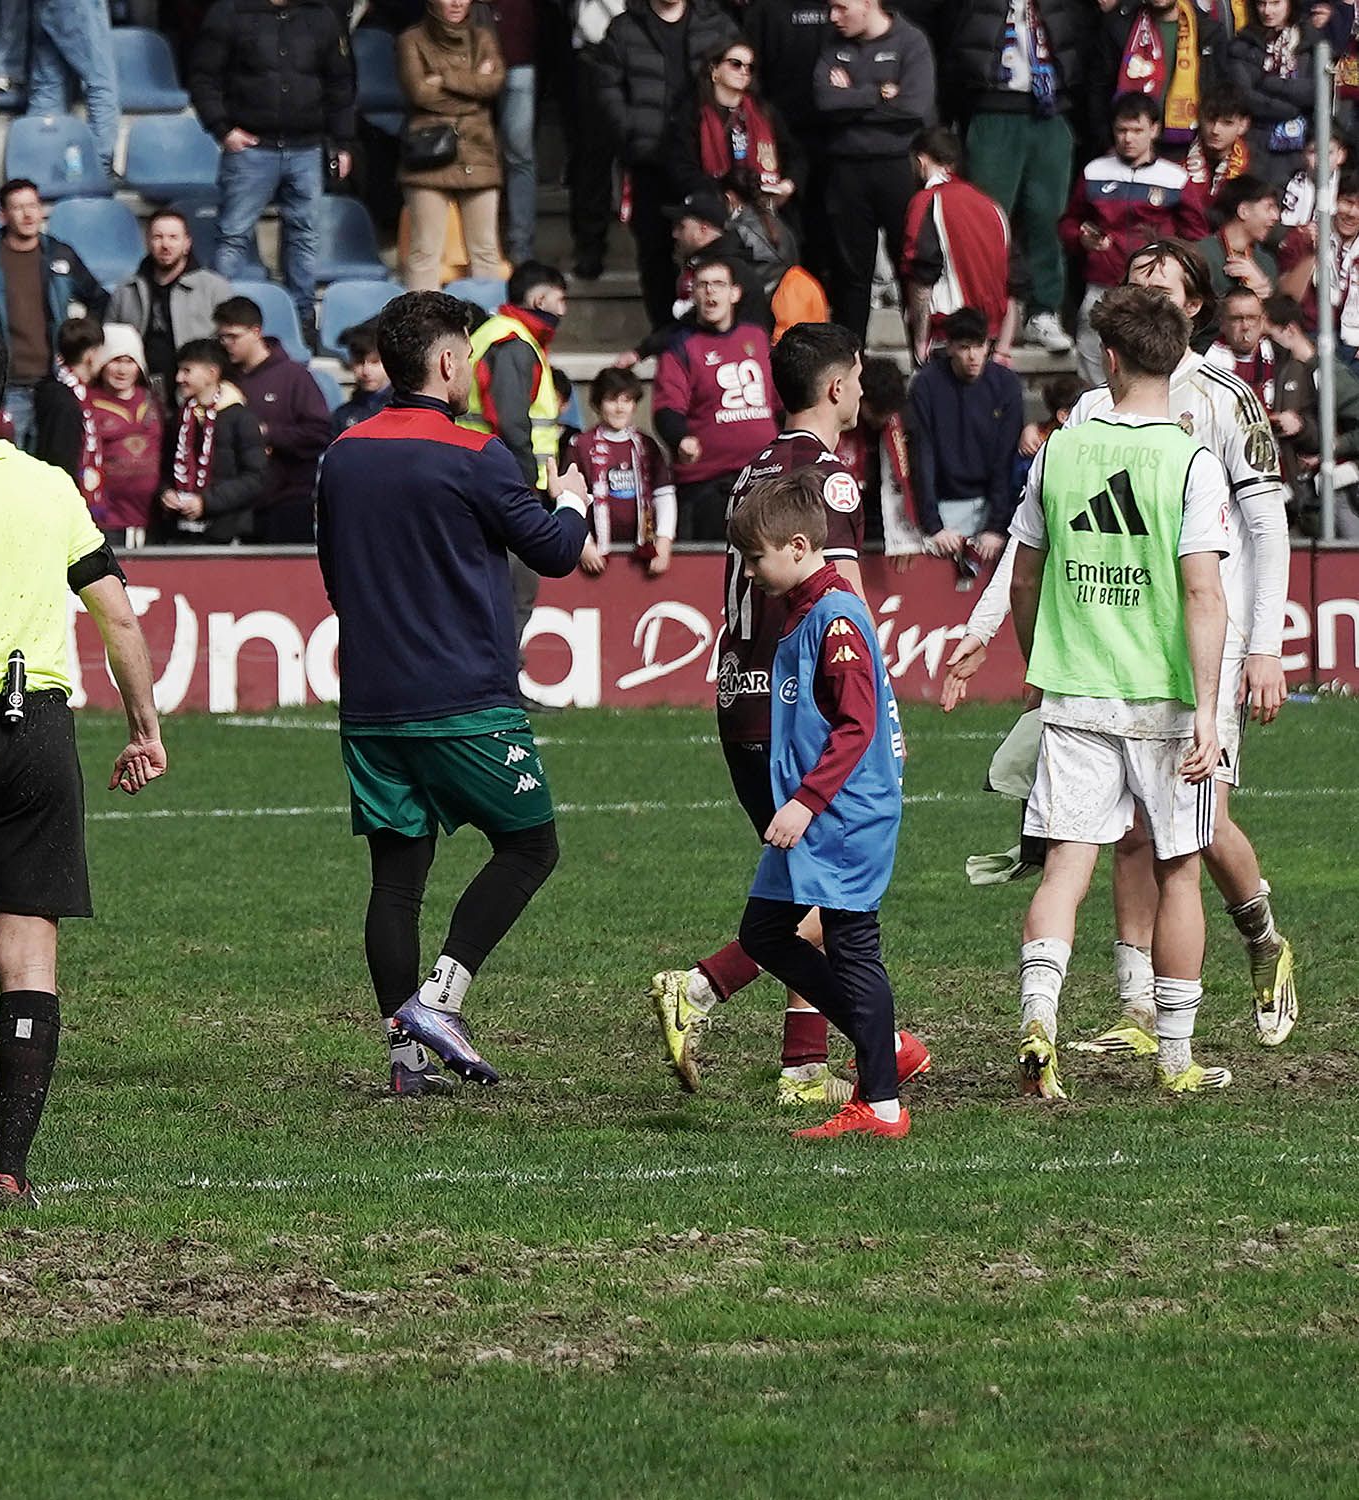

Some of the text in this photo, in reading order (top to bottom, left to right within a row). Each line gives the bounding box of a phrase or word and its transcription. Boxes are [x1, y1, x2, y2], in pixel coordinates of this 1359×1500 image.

[1076, 443, 1162, 469] PALACIOS
[1065, 560, 1152, 586] Emirates
[1077, 585, 1140, 607] FLY BETTER
